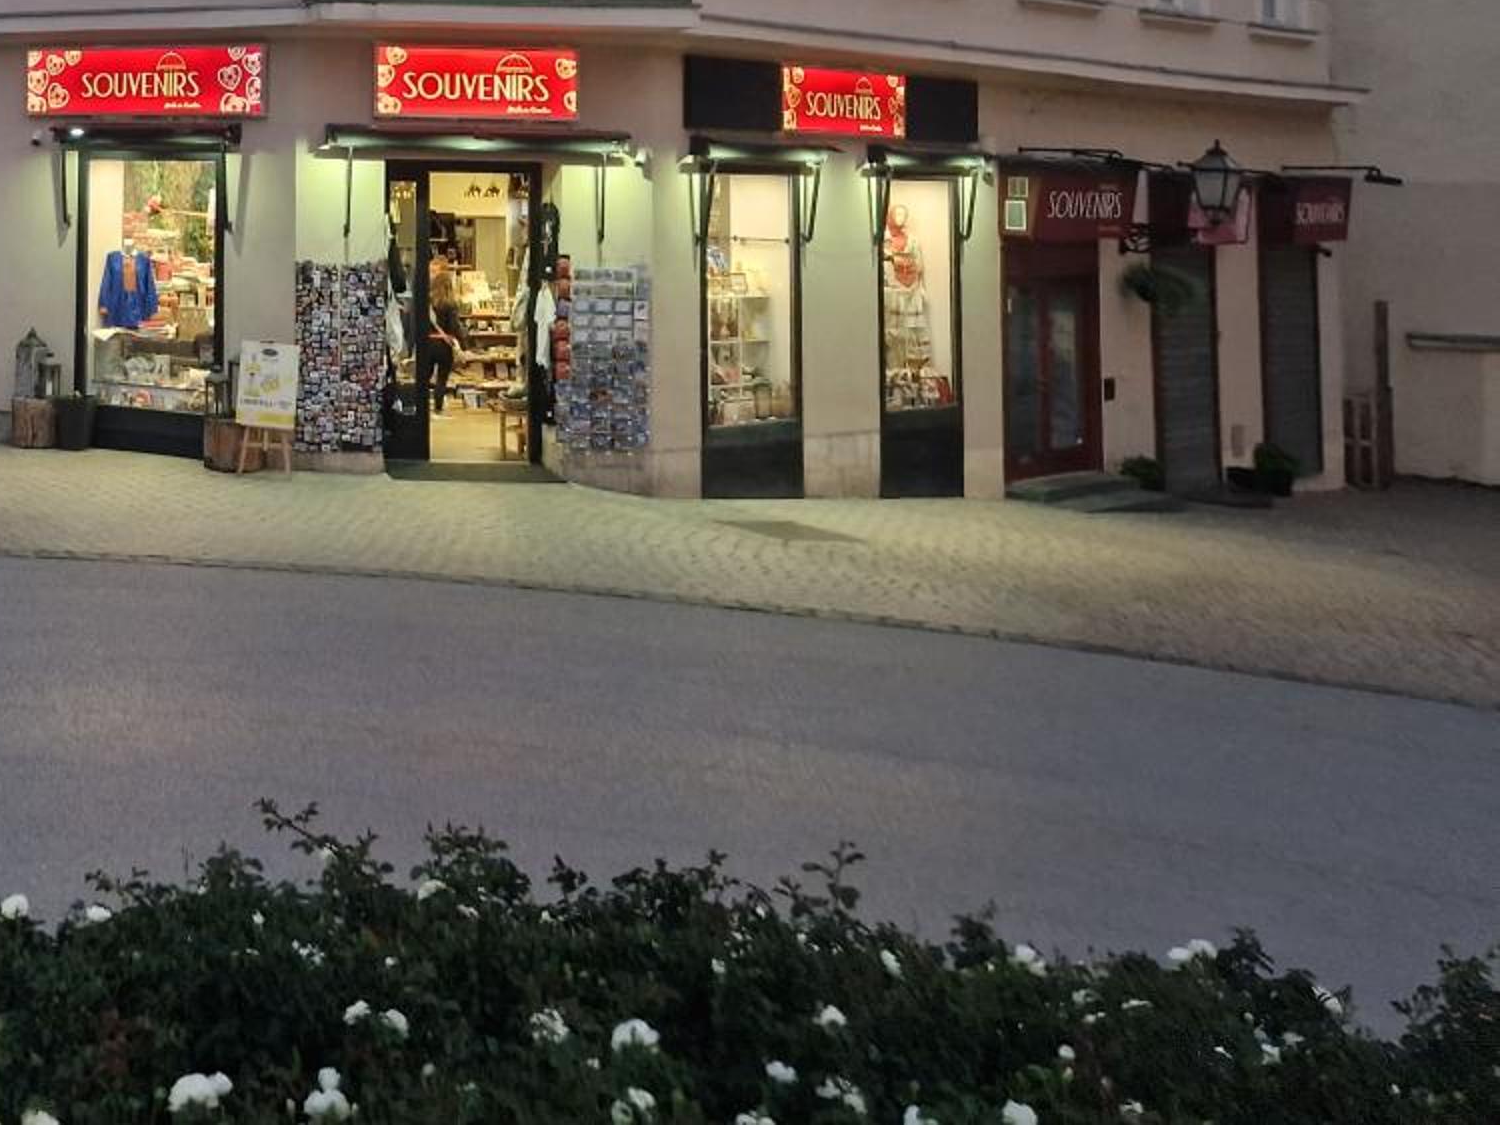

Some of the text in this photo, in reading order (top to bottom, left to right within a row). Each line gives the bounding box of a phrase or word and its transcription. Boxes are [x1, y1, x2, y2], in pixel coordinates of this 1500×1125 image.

[81, 72, 200, 98] SOUVENIRS
[402, 72, 549, 102] SOUVENIRS
[805, 91, 882, 120] SOUVENIRS
[1047, 190, 1123, 220] SOUVENIRS
